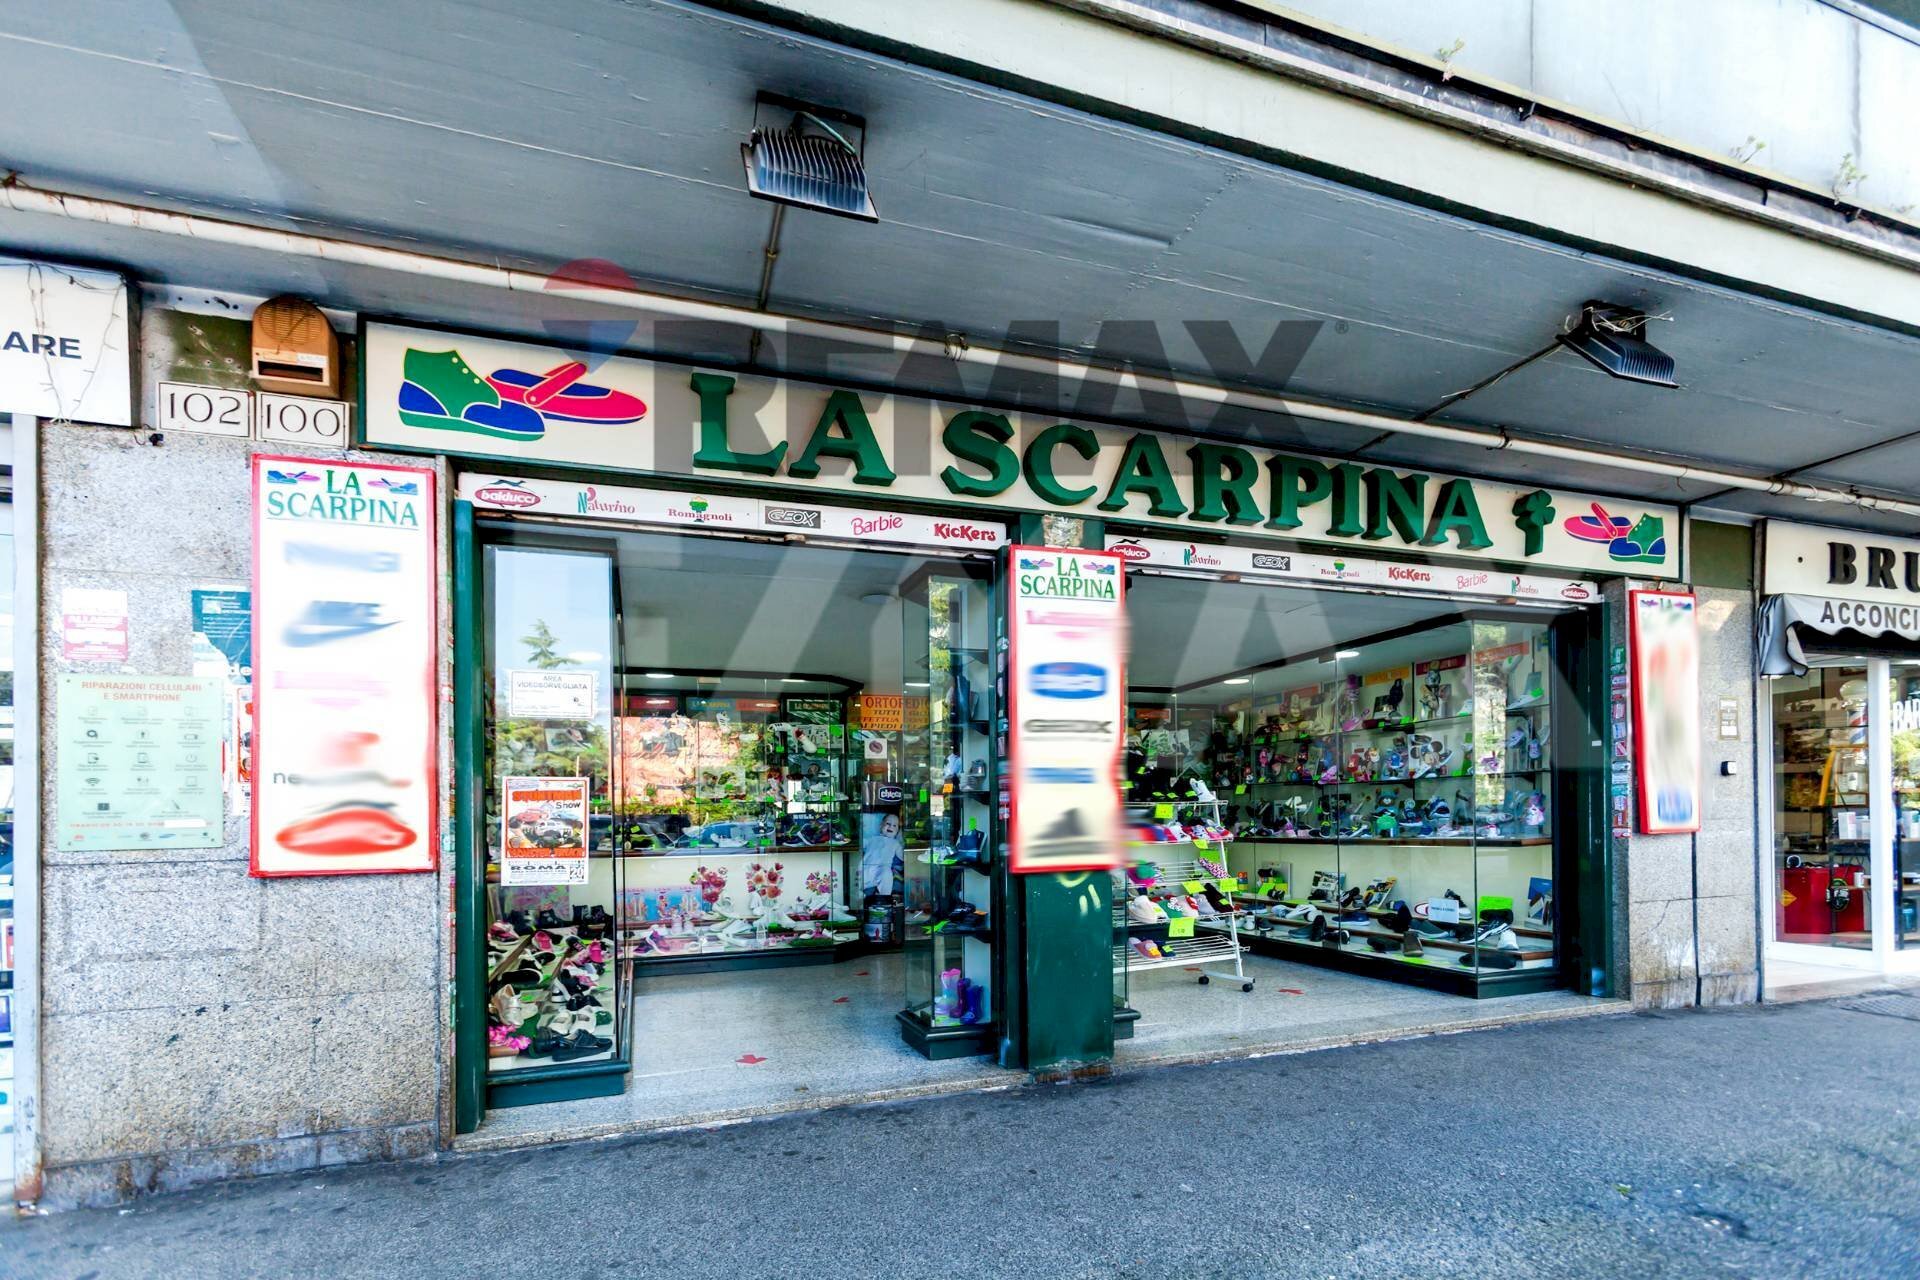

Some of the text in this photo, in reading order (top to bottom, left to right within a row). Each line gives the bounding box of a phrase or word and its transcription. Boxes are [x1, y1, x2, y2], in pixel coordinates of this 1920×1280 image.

[169, 391, 241, 425] 102
[265, 403, 341, 437] 100
[689, 371, 1494, 552] LA SCARPINA
[326, 469, 362, 496] LA
[266, 489, 420, 527] SCARPINA
[668, 508, 733, 521] Romagnoli
[768, 508, 818, 528] GEOX
[850, 515, 903, 536] Barbie
[1057, 556, 1081, 577] LA
[1020, 574, 1116, 599] SCARPINA
[1456, 573, 1488, 590] Barbie
[1819, 601, 1918, 631] ACCONCI
[81, 681, 146, 690] RIPARAZIONI
